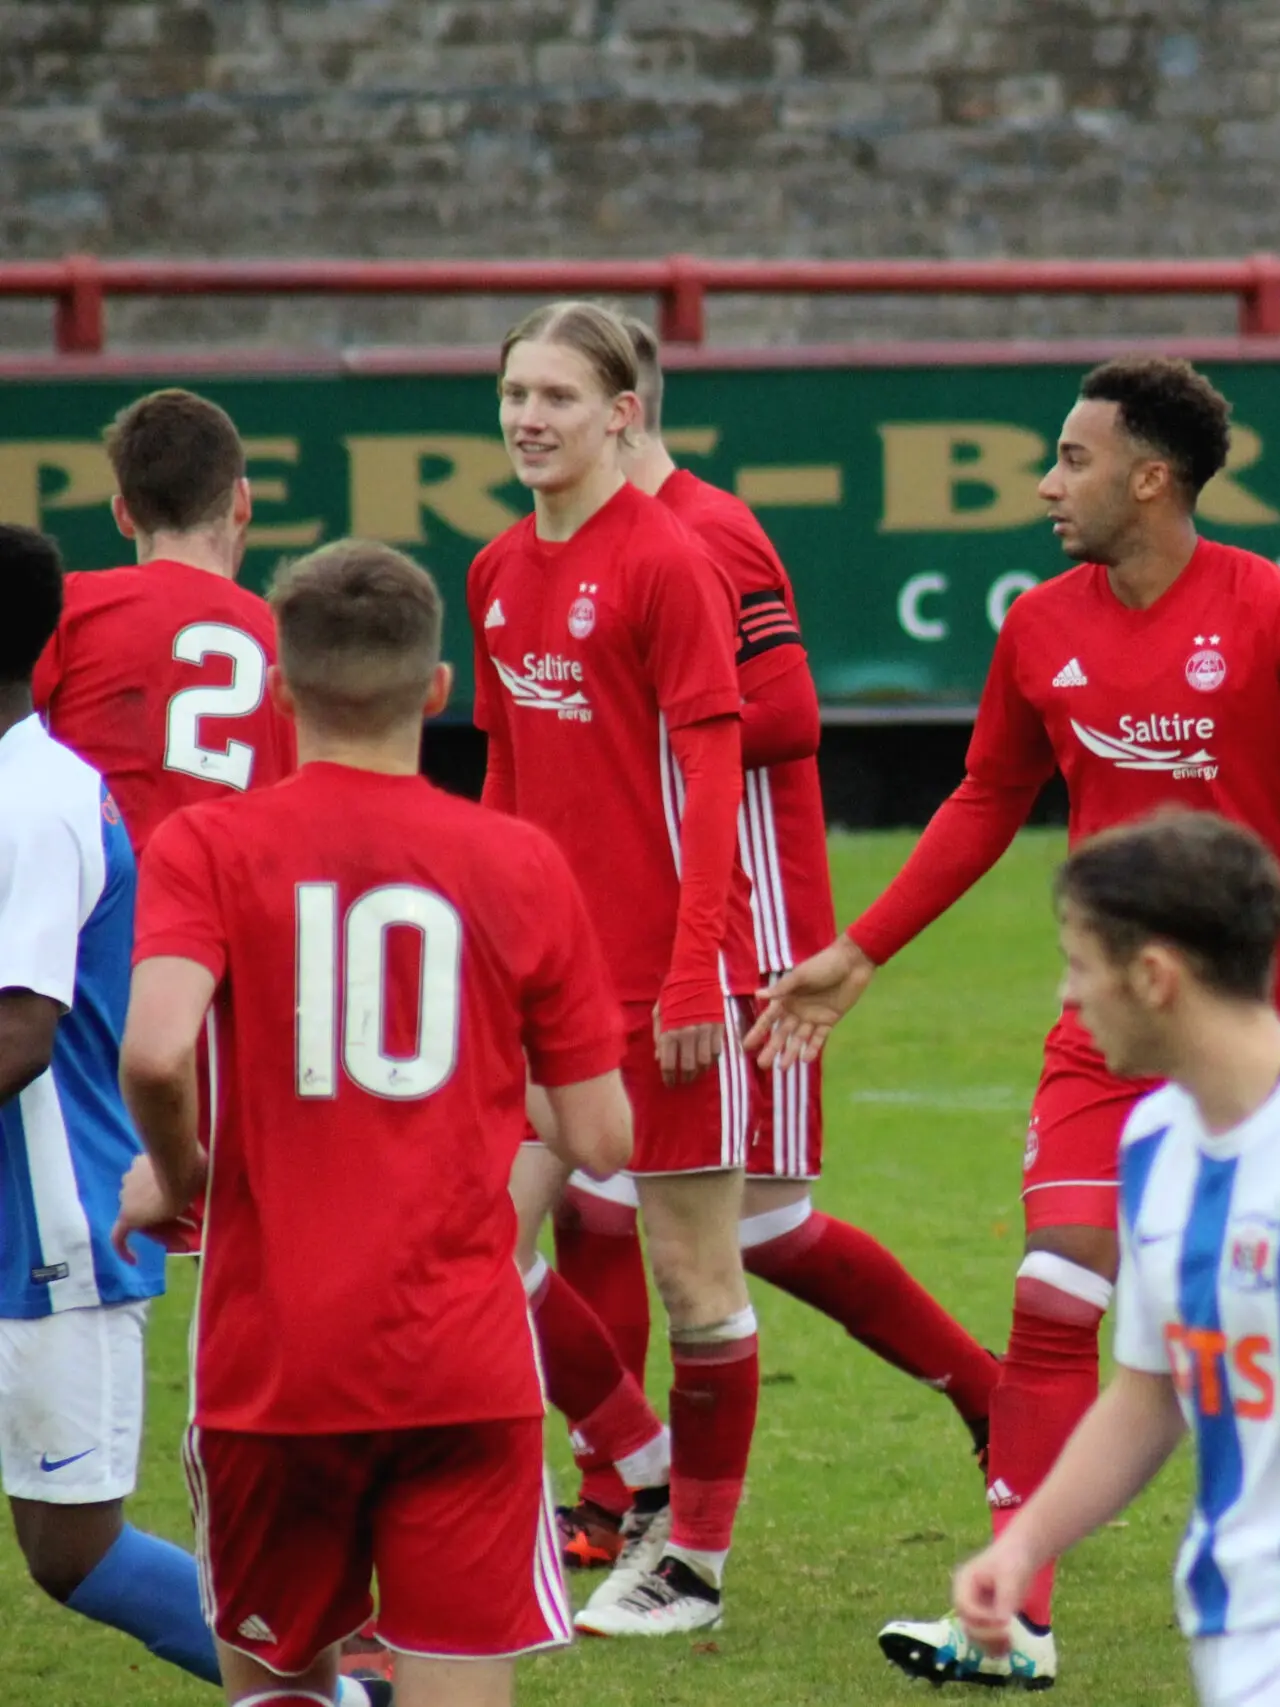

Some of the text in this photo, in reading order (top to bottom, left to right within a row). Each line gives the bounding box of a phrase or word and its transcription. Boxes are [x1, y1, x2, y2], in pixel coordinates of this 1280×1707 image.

[523, 653, 584, 682] Saltire
[163, 621, 268, 793] 2
[557, 708, 593, 723] energy
[1119, 713, 1215, 743] Saltire
[1172, 765, 1219, 781] energy
[295, 881, 464, 1101] 10
